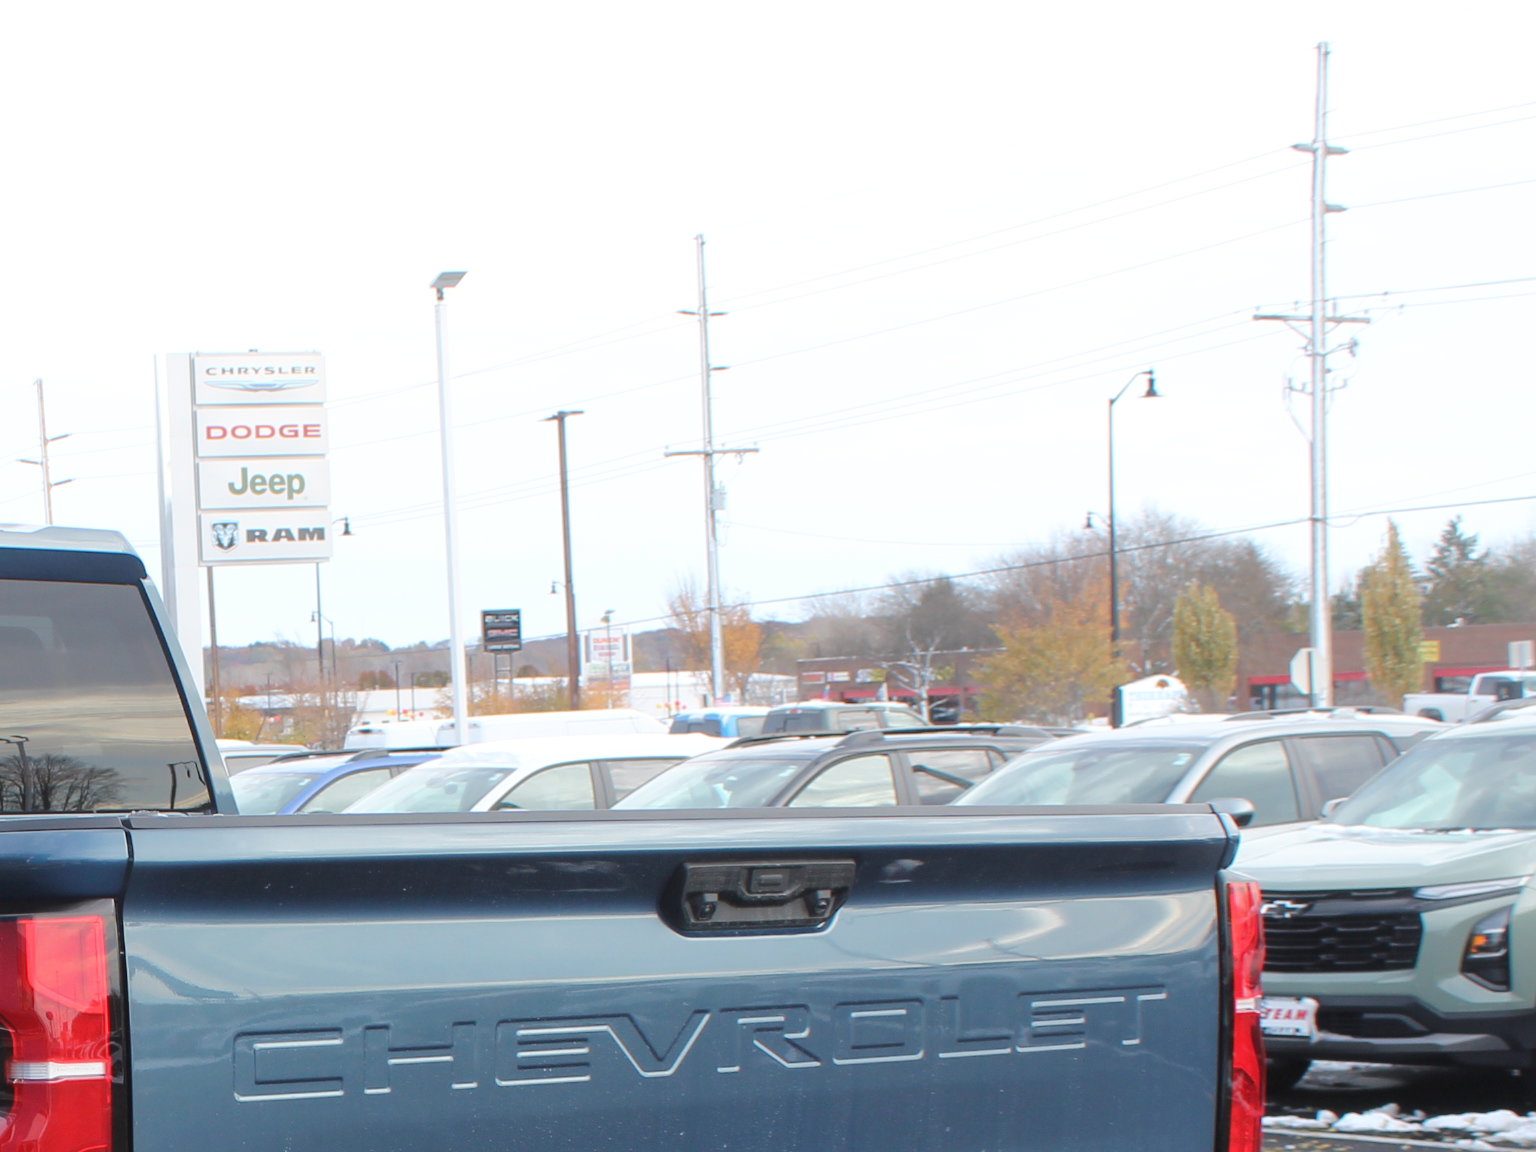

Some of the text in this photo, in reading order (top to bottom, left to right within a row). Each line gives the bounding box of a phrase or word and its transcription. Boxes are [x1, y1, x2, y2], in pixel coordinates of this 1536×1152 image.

[205, 366, 317, 377] CHRYSLER
[206, 424, 322, 440] DODGE
[228, 467, 306, 500] Jeep
[246, 527, 326, 543] RAM
[1265, 1008, 1308, 1020] TEAM
[233, 984, 1168, 1104] CHEVROLET
